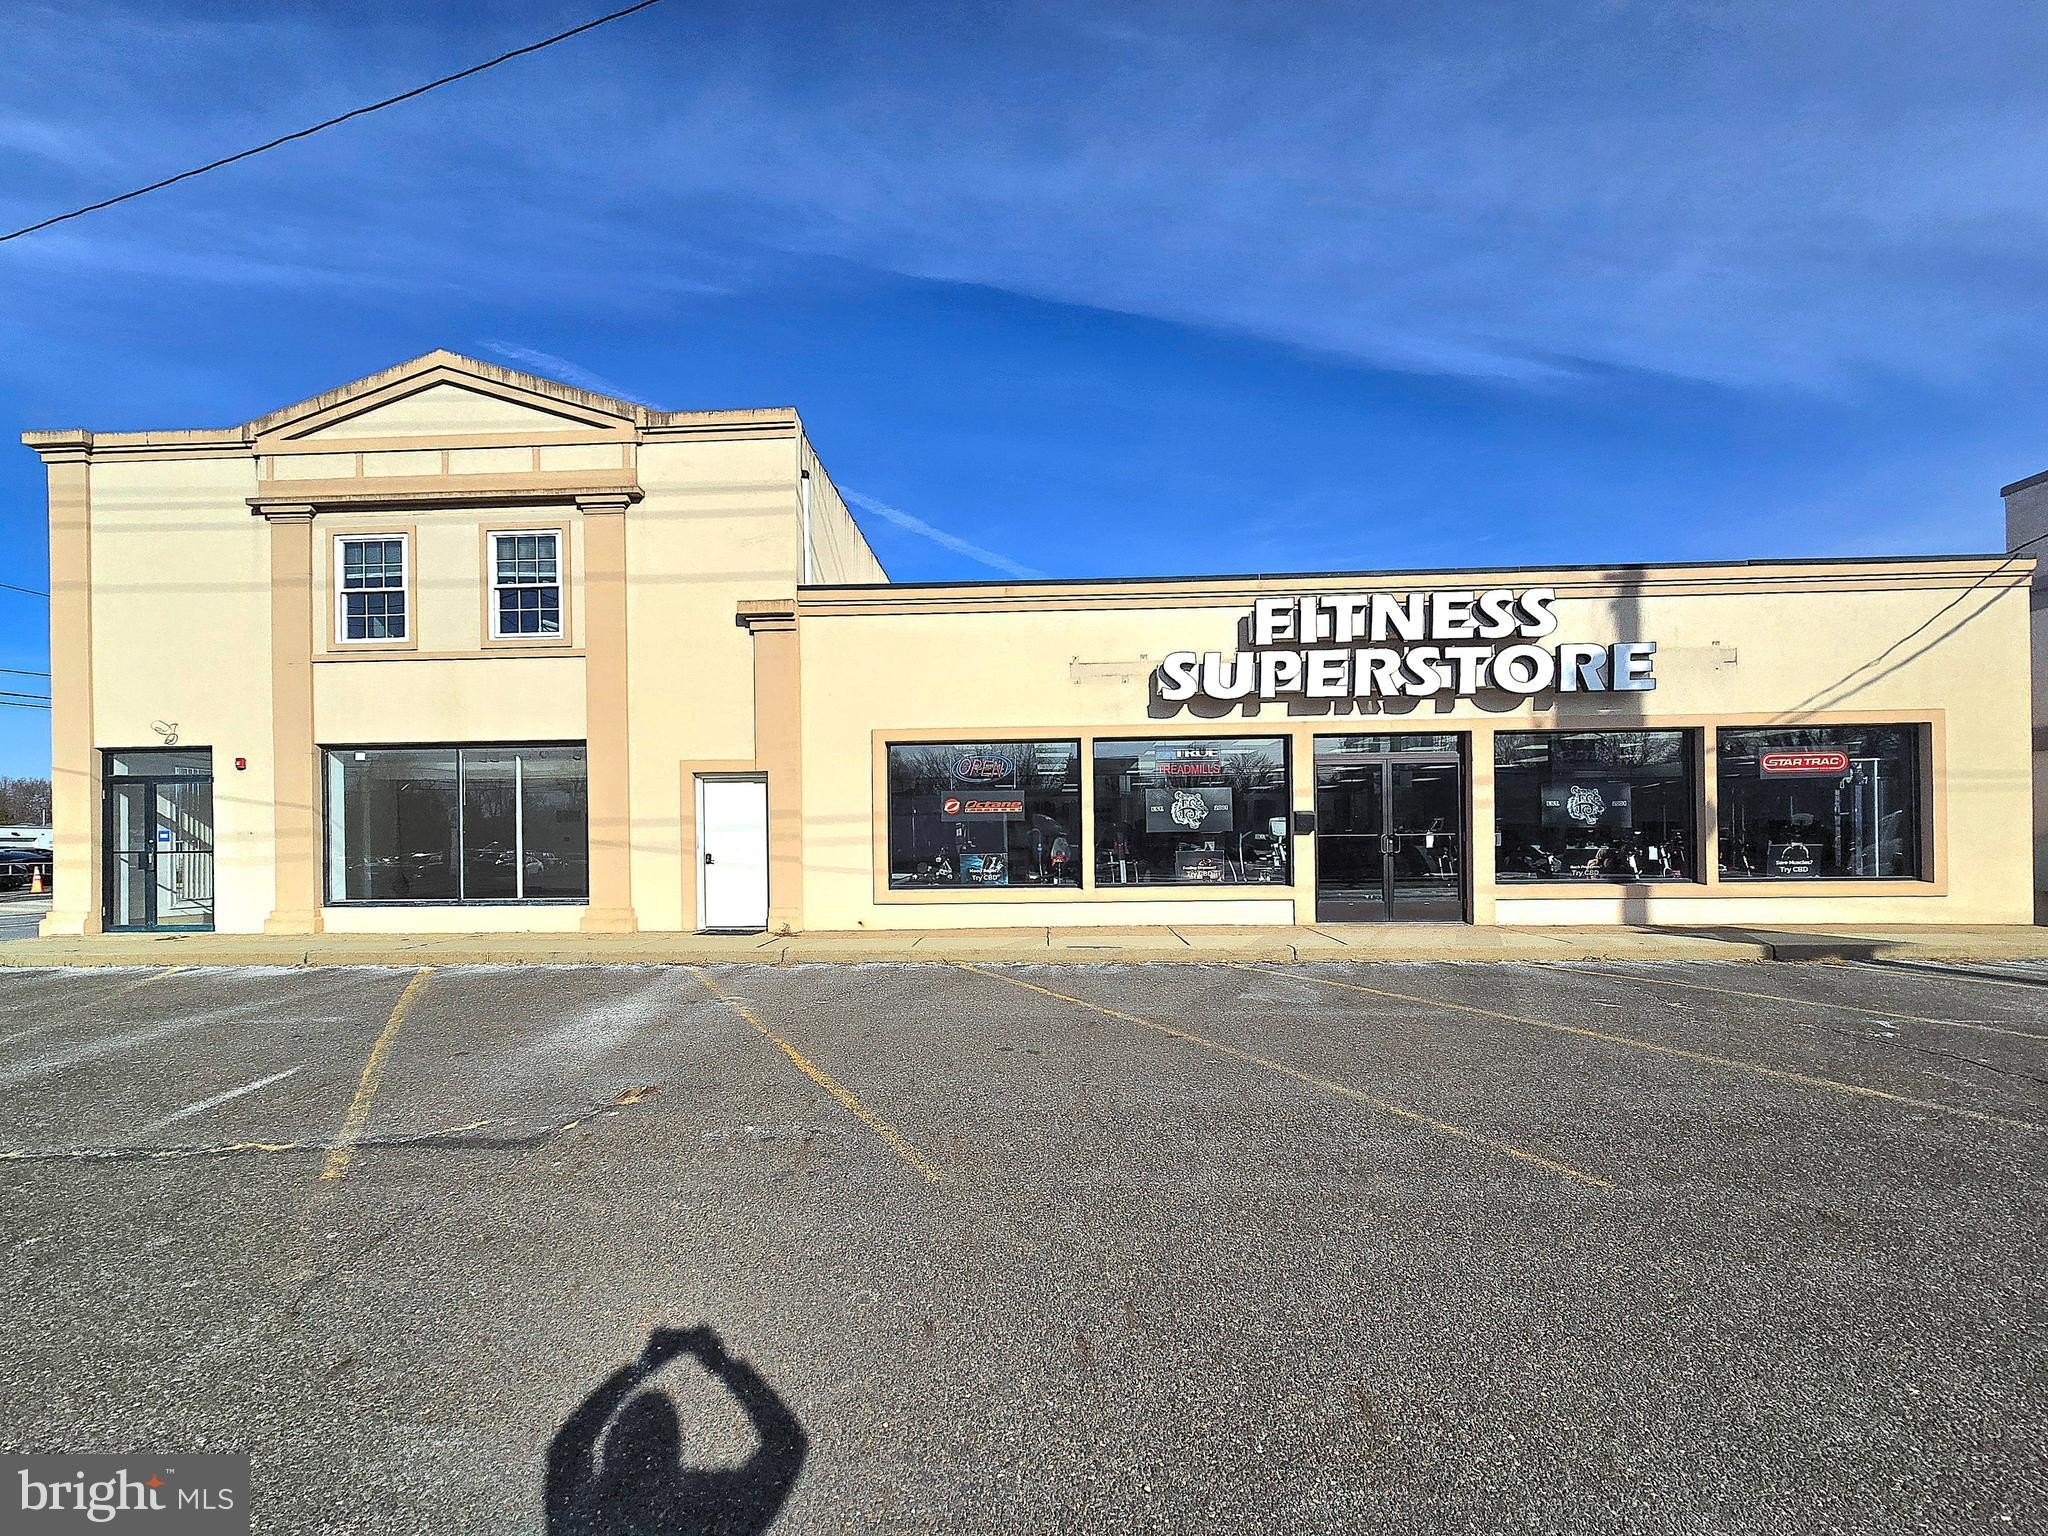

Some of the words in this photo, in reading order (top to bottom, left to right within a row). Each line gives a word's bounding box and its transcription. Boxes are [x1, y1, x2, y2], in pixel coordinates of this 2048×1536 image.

[1253, 588, 1558, 646] FITNESS
[1158, 641, 1657, 701] SUPERSTORE
[1768, 758, 1802, 767] STAR
[1803, 757, 1840, 766] TRAC
[959, 758, 1005, 778] OPEN
[1158, 763, 1221, 775] TREADMILLS
[965, 800, 1022, 808] Octane
[1571, 869, 1584, 878] Try
[1779, 866, 1791, 874] Try
[971, 874, 983, 882] Try
